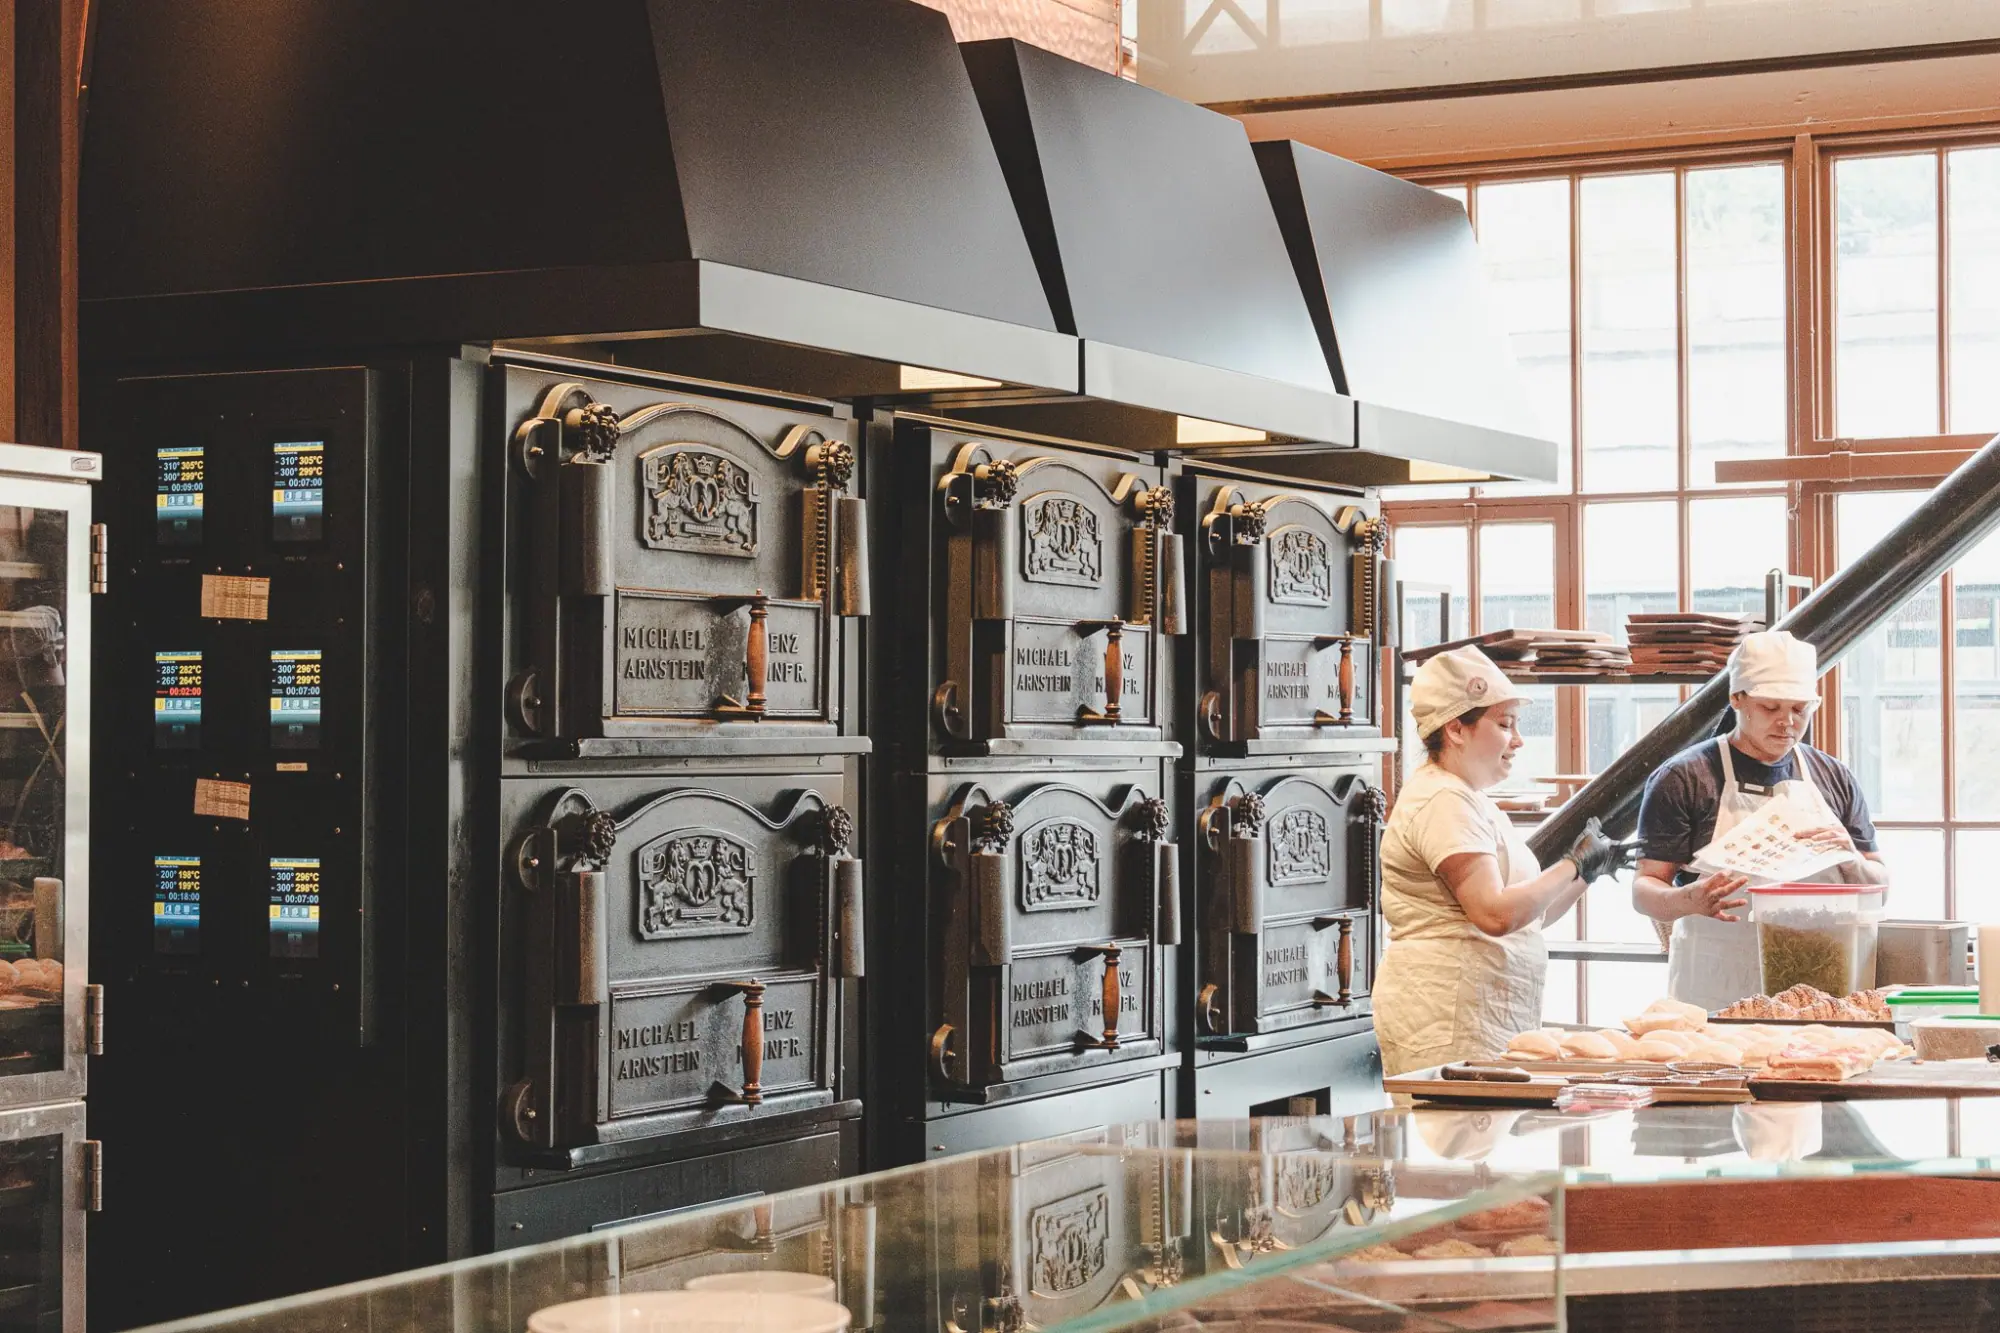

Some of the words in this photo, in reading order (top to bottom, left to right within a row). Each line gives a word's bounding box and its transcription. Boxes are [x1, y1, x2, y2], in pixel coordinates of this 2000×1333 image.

[624, 626, 706, 650] MICHAEL
[1016, 648, 1072, 666] MICHAEL
[624, 658, 705, 681] ARNSTEIN
[1266, 662, 1309, 677] MICHAEL
[1016, 674, 1071, 692] ARNSTEIN
[1266, 684, 1309, 699] ARNSTEIN
[1266, 944, 1309, 964] MICHAEL
[1266, 966, 1309, 987] ARNSTEIN
[1014, 978, 1069, 1001] MICHAEL
[1013, 1003, 1068, 1028] ARNSTEIN
[618, 1020, 700, 1050] MICHAEL
[617, 1050, 700, 1081] ARNSTEIN
